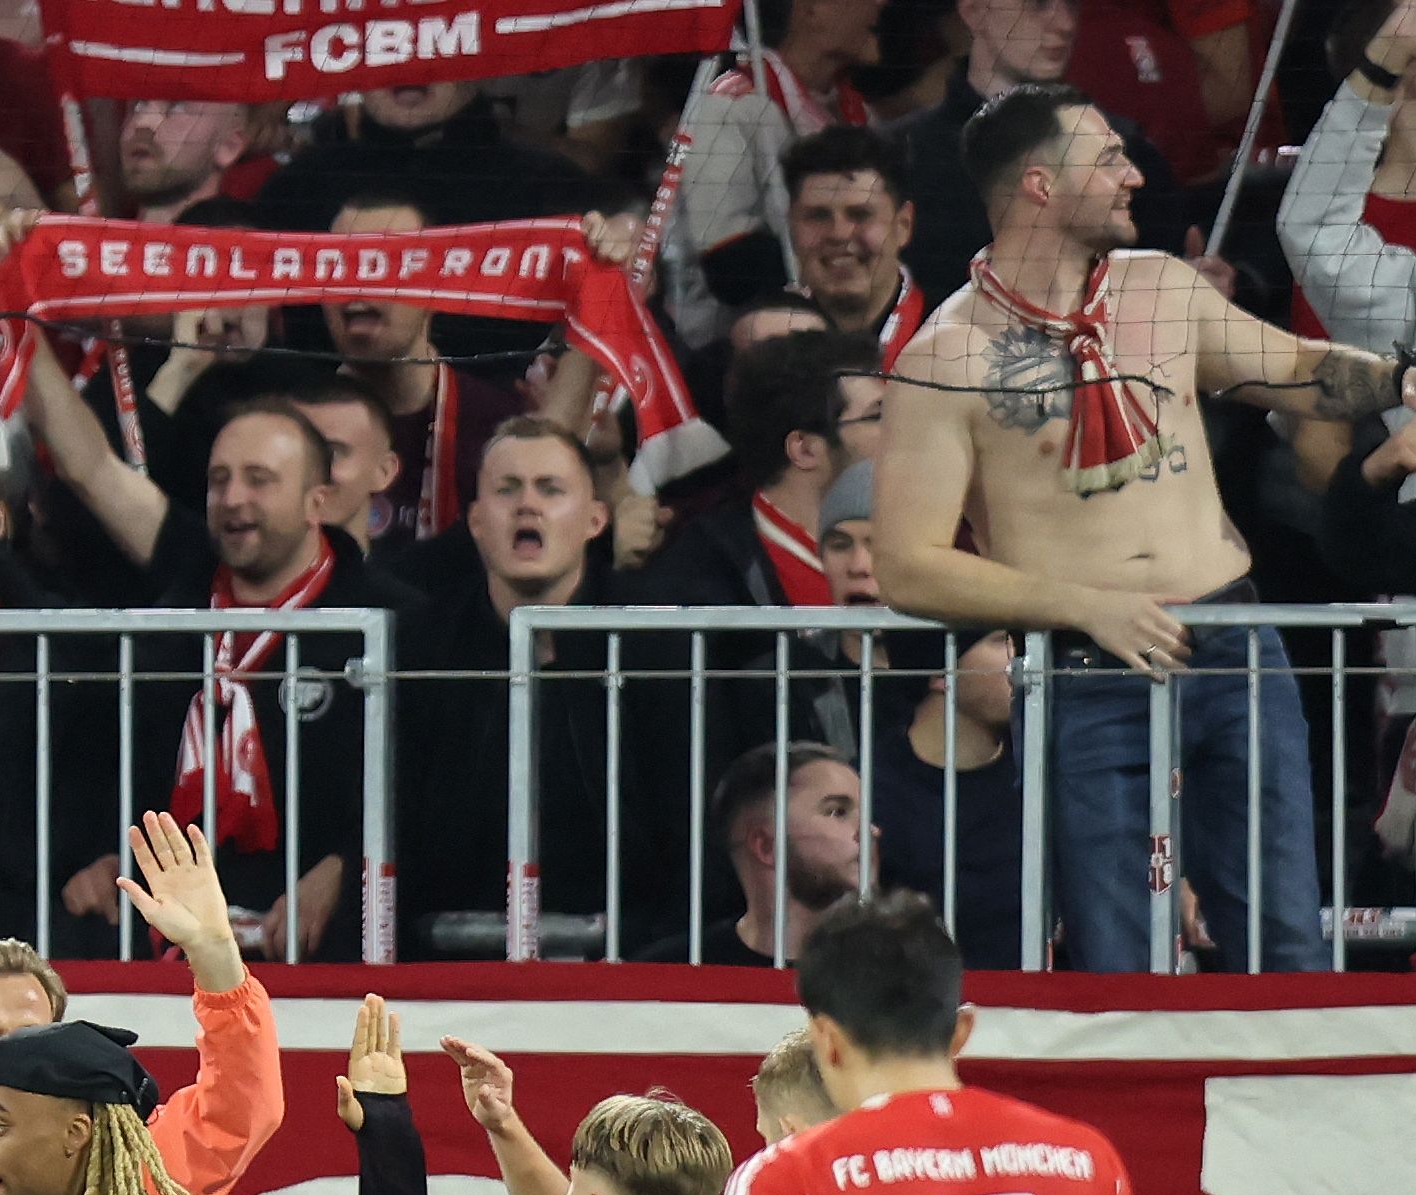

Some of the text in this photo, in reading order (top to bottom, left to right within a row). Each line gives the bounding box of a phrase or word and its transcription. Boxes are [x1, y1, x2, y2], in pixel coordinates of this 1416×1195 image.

[264, 11, 480, 80] FCBM
[832, 1155, 870, 1191] FC
[873, 1148, 976, 1182] BAYERN
